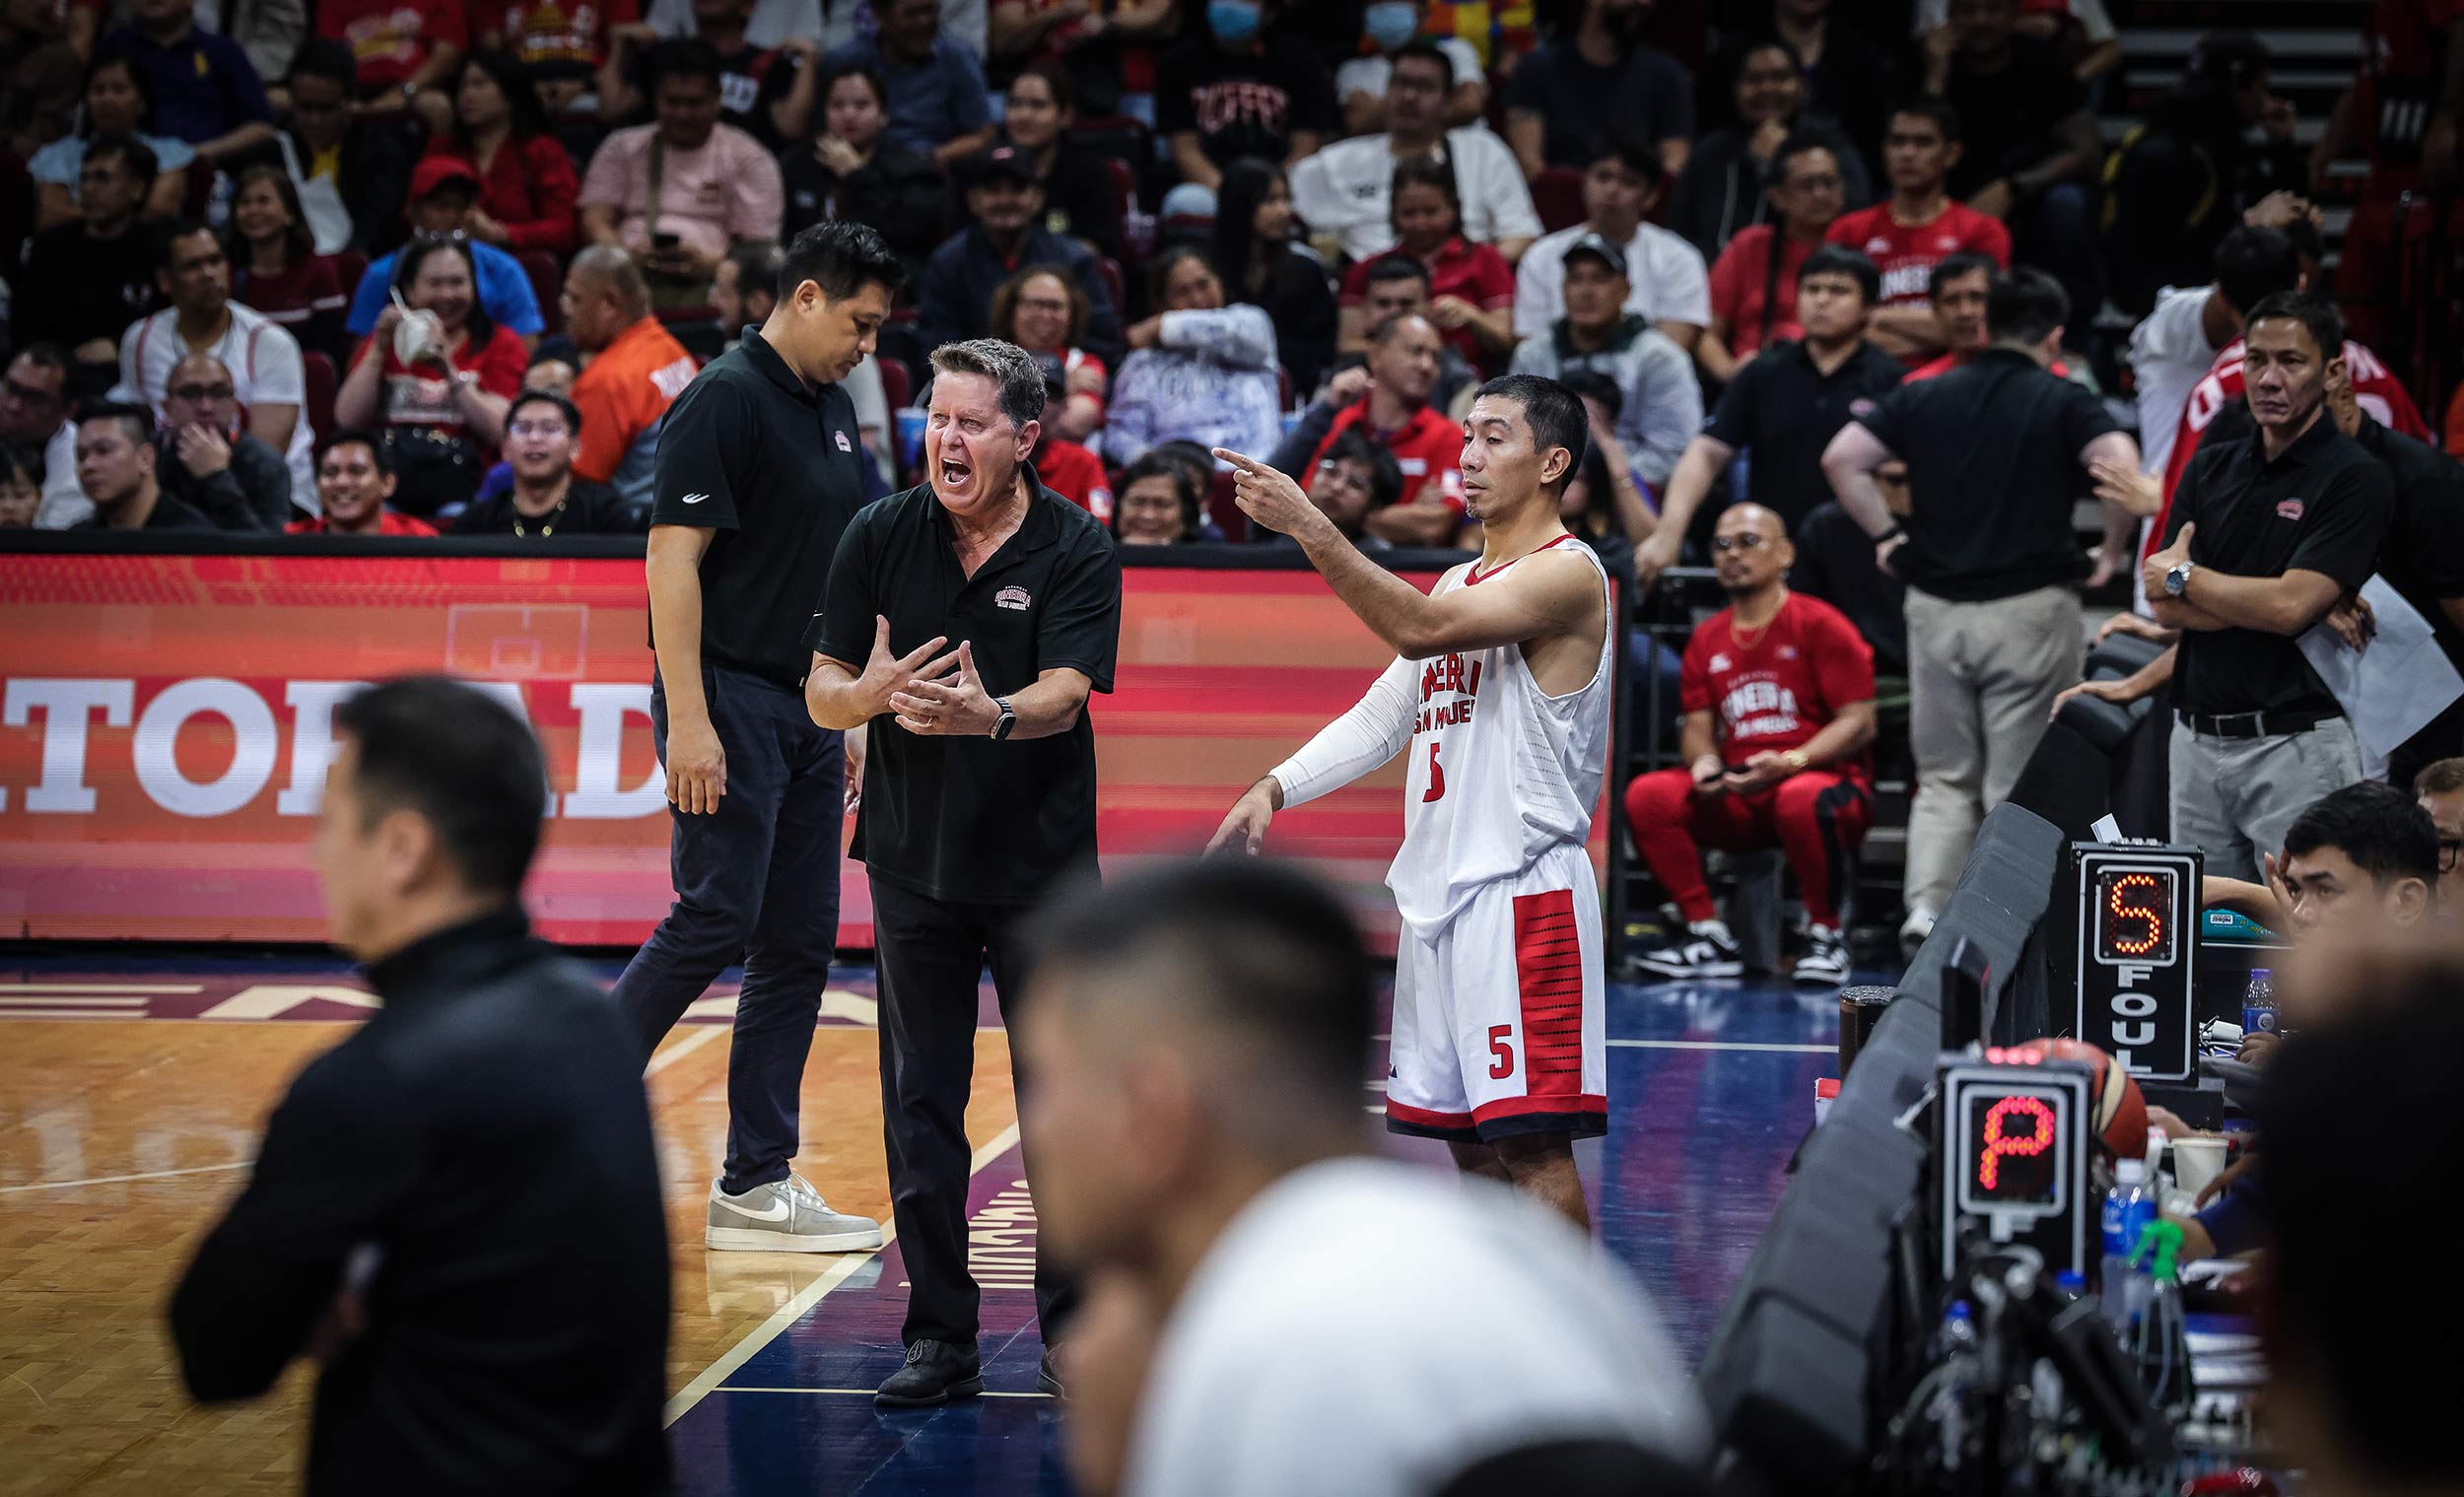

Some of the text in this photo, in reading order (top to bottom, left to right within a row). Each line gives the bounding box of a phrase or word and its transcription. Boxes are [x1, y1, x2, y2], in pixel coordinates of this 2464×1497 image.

[1488, 1024, 1515, 1080] 5
[2110, 964, 2158, 1074] FOUL
[1979, 1095, 2056, 1191] P
